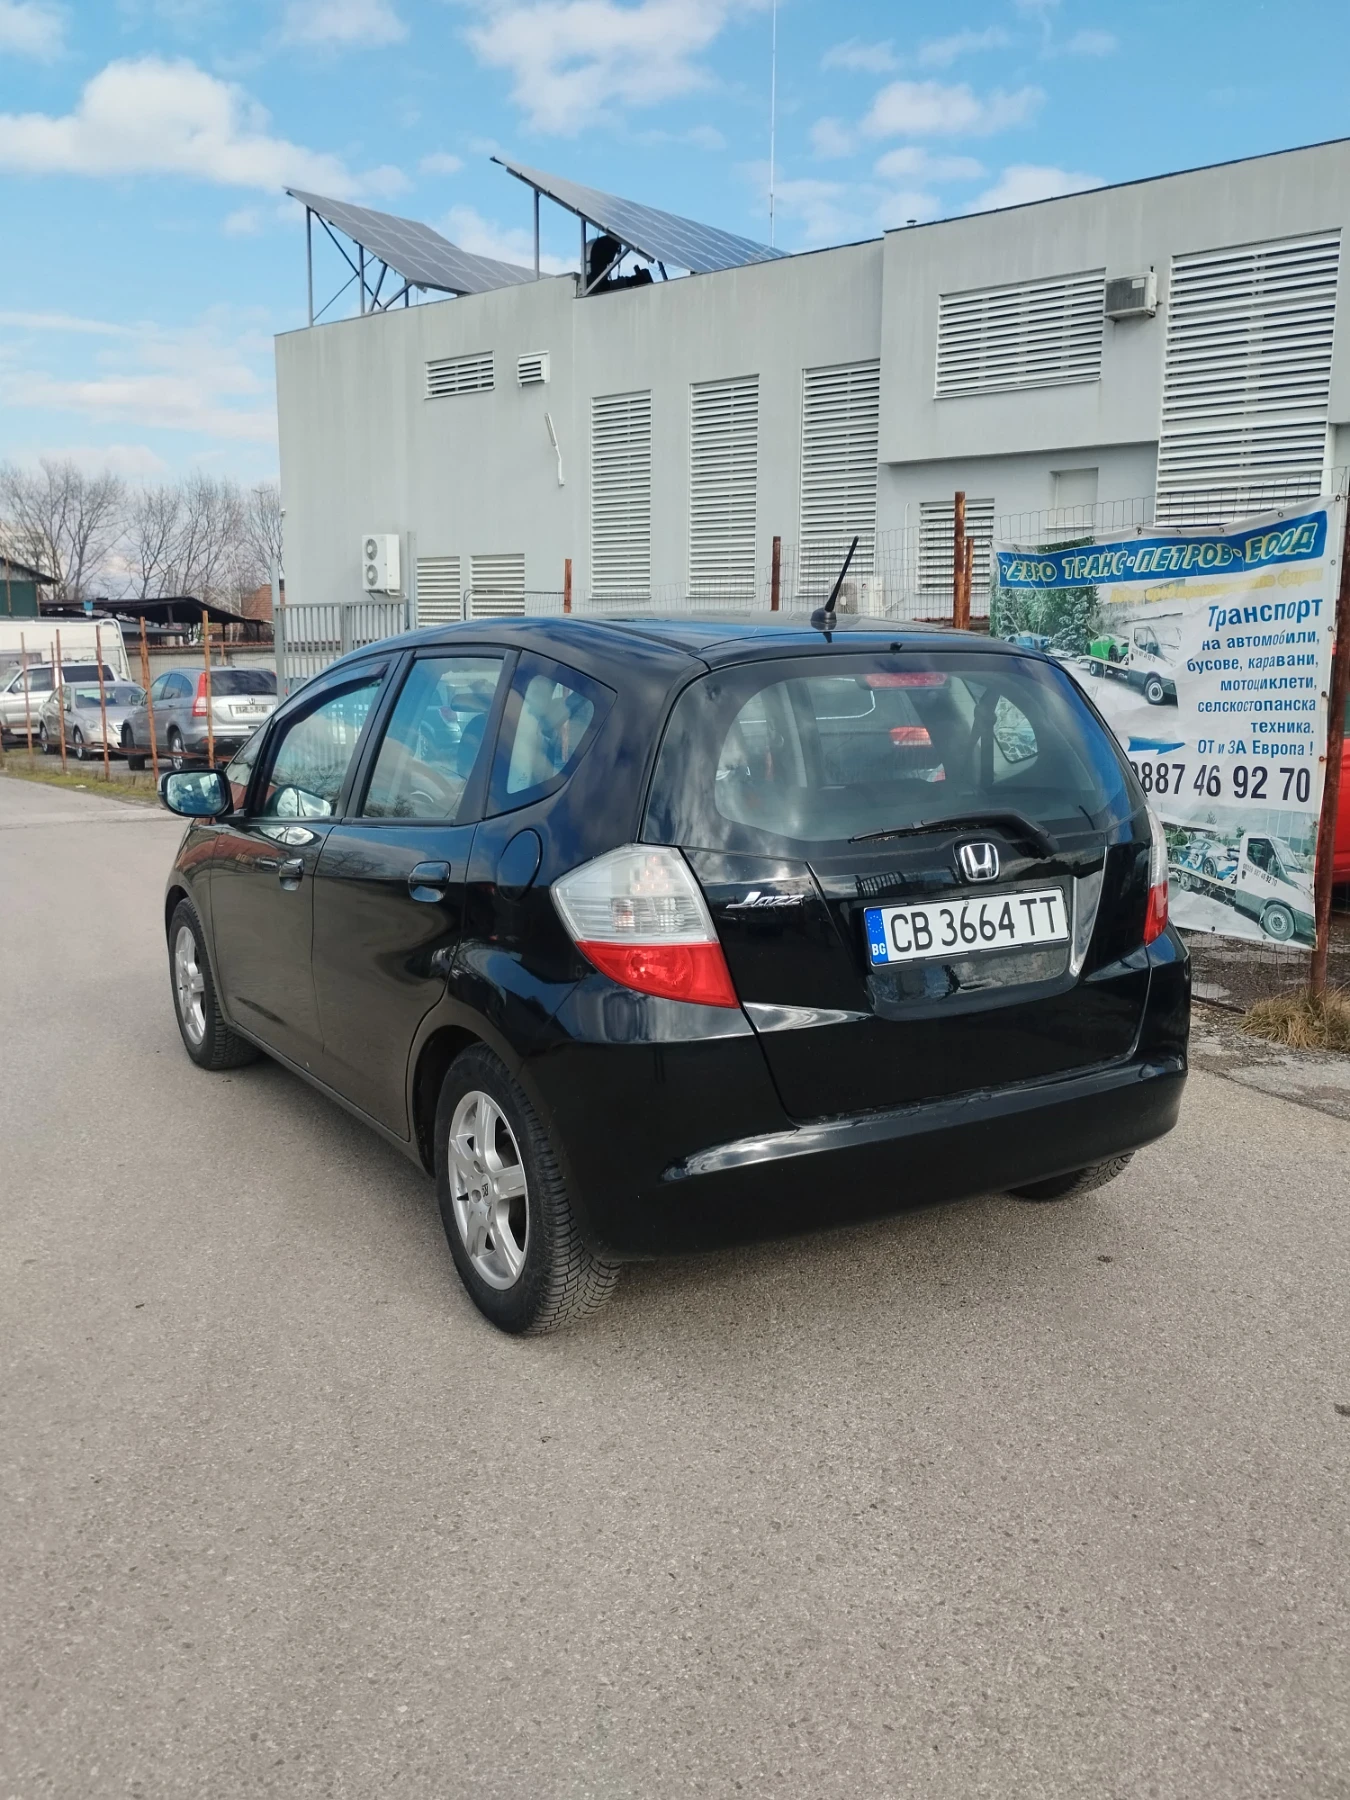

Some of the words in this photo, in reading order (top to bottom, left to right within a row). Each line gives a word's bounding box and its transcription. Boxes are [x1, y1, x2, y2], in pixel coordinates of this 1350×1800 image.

[1245, 522, 1318, 563] ЕООД
[1208, 597, 1324, 633] Транспорт
[1202, 639, 1221, 651] на
[1226, 631, 1320, 649] автомобили,
[1187, 657, 1243, 674] бусове,
[1248, 653, 1319, 669] каравани,
[1220, 677, 1318, 692] мотоциклети,
[1197, 699, 1317, 714] селскостопанска
[1250, 721, 1315, 734] техника.
[1197, 739, 1215, 754] ОТ
[1252, 739, 1306, 758] Европа
[1193, 764, 1222, 797] 46
[1232, 765, 1268, 800] 92
[1279, 767, 1311, 803] 70
[725, 891, 805, 909] Jazz
[871, 942, 887, 956] BG
